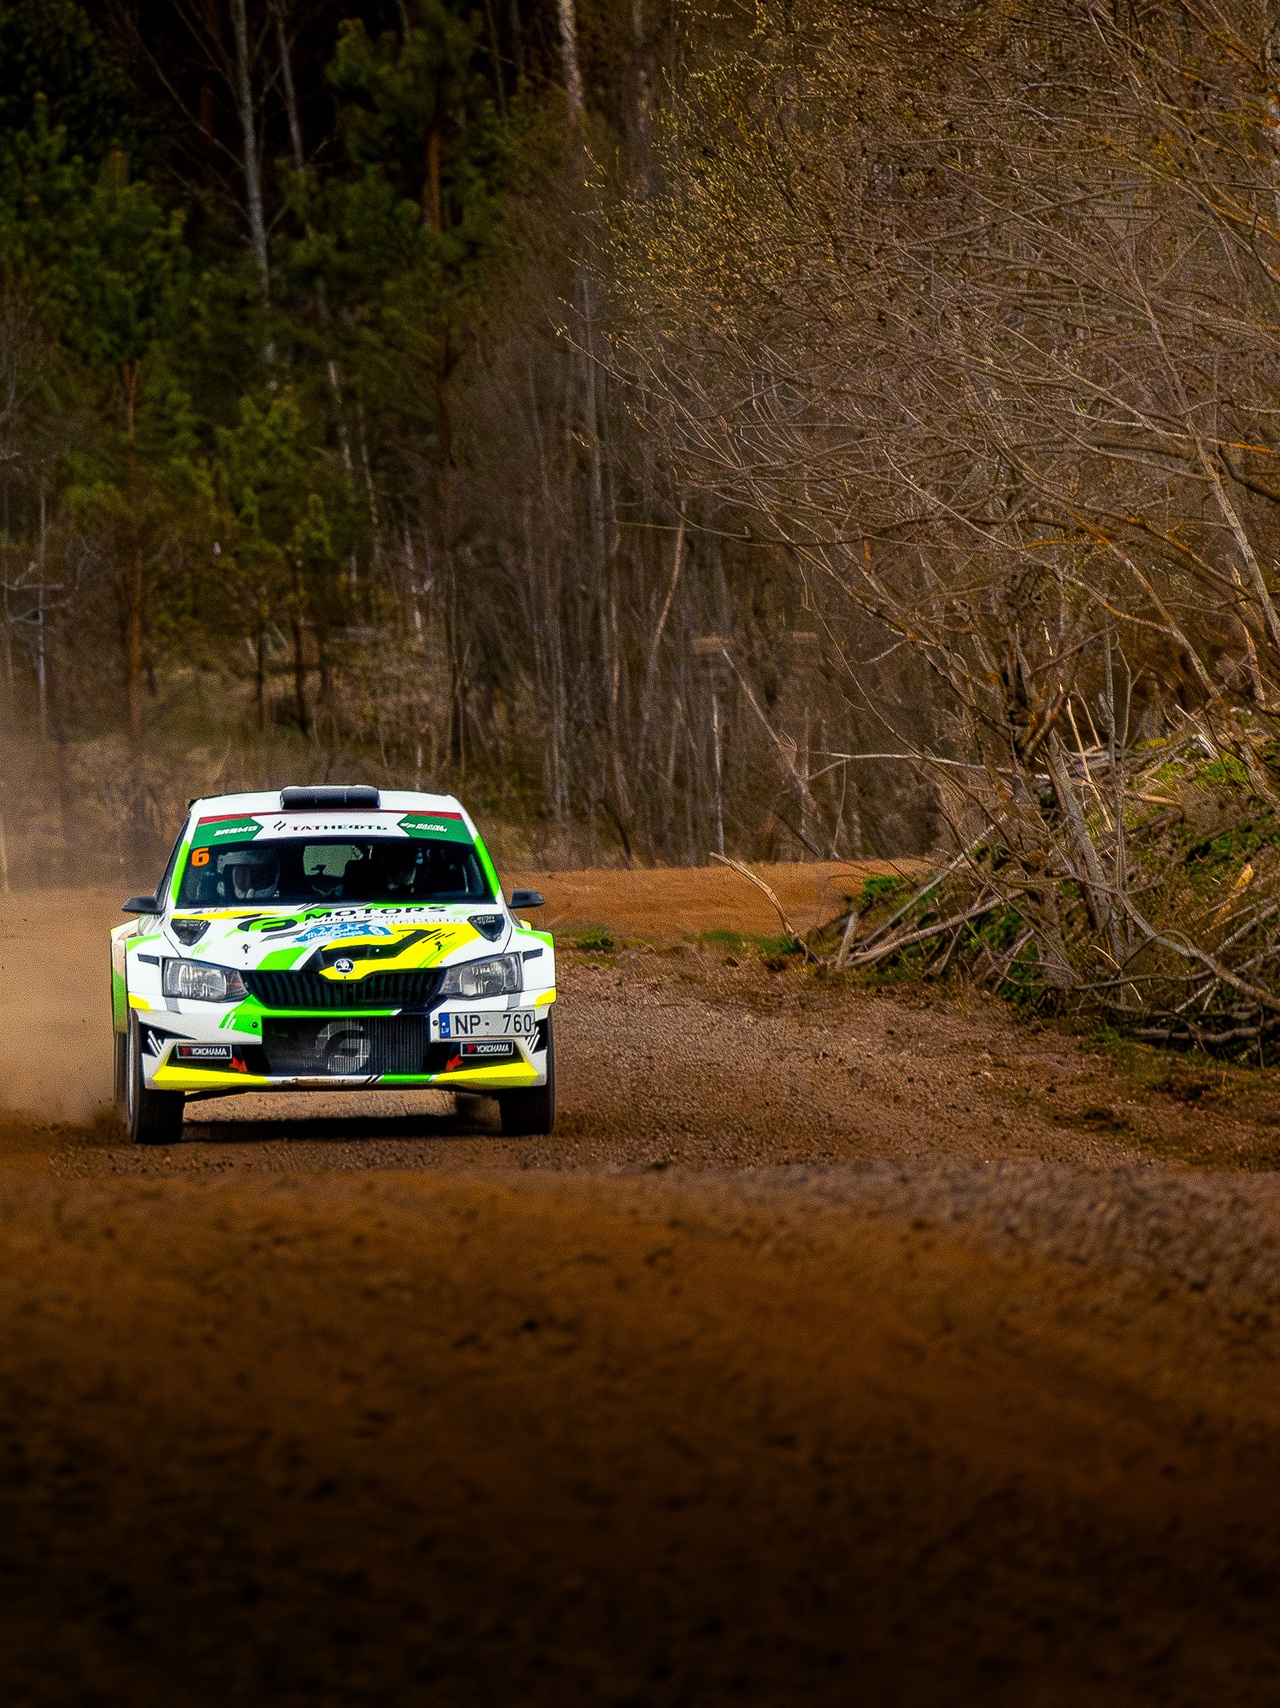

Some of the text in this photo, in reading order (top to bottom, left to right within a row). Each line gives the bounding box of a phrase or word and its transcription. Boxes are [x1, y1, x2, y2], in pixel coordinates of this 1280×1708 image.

[191, 847, 210, 867] 6
[305, 906, 446, 921] MOTORS
[503, 1014, 532, 1034] 760
[192, 1047, 227, 1055] YOKOHAMA
[476, 1044, 509, 1053] YOKOHAMA
